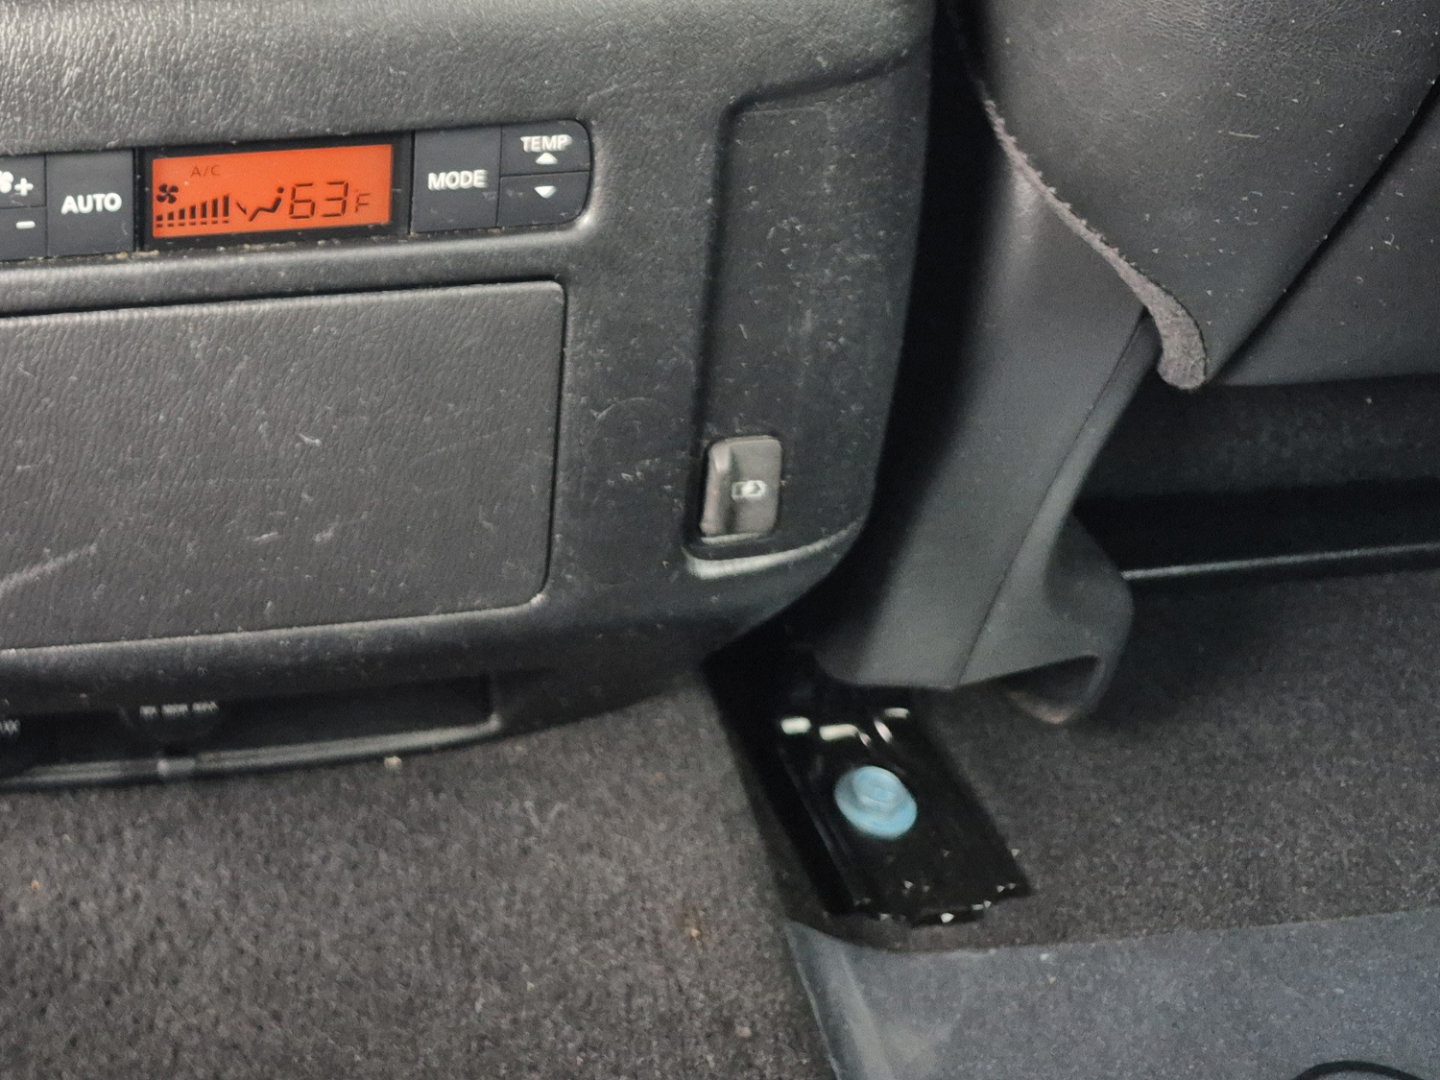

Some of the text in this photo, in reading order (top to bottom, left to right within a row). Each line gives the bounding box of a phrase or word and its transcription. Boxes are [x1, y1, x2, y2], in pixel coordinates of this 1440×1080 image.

[520, 134, 573, 153] TEMP
[190, 164, 221, 178] A/C
[428, 169, 488, 191] MODE
[61, 192, 122, 215] AUTO
